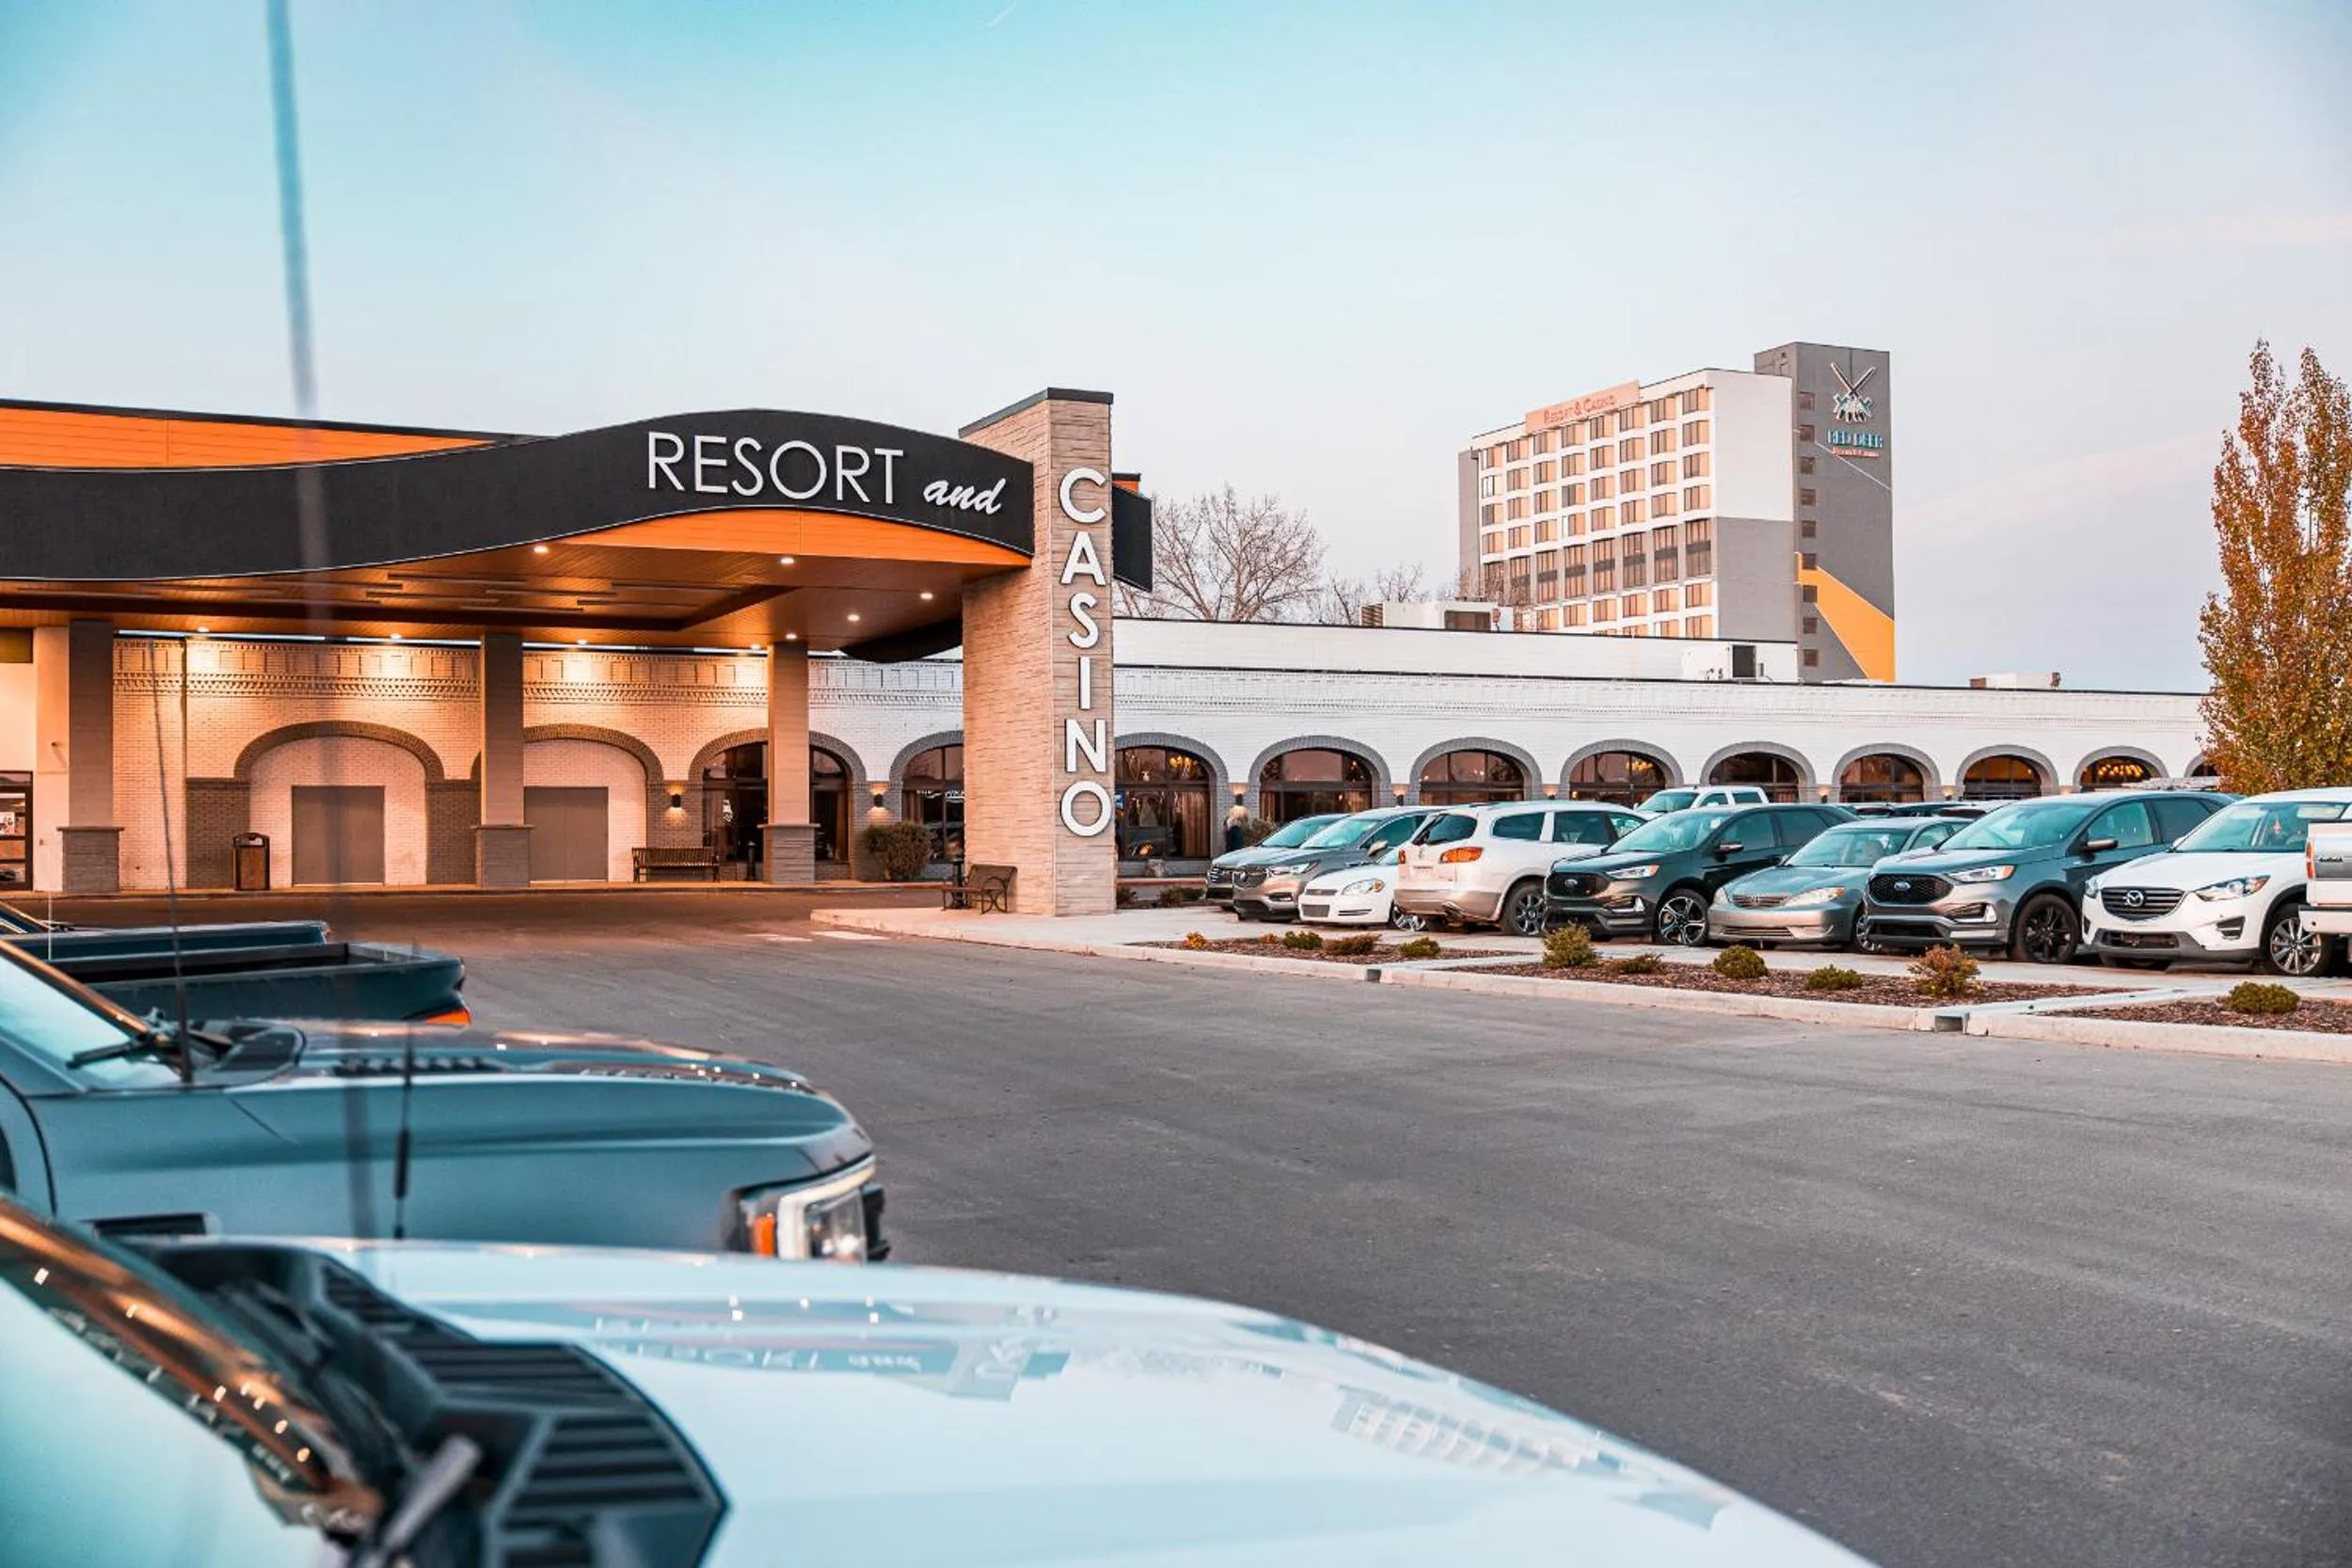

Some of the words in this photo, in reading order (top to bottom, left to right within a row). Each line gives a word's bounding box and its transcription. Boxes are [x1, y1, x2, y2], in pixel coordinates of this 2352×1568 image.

[647, 431, 904, 504] RESORT
[923, 478, 1007, 515] and
[1059, 467, 1112, 837] CASINO
